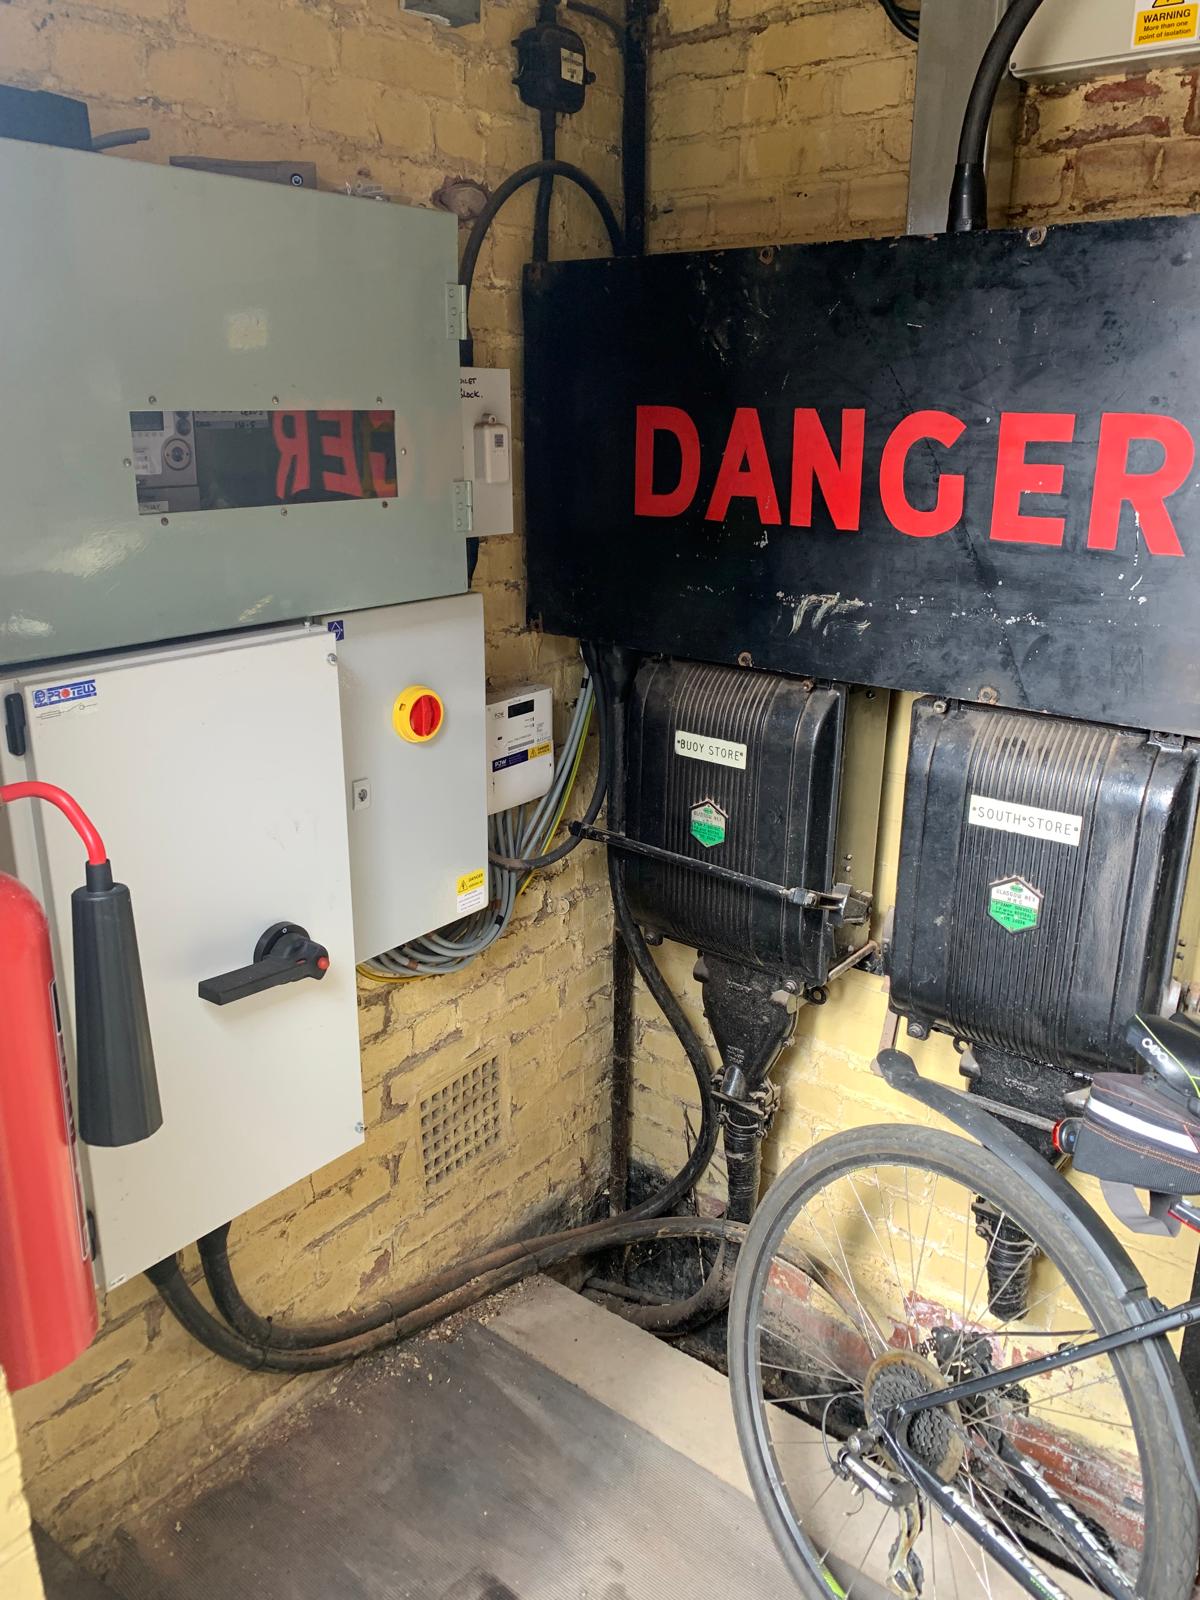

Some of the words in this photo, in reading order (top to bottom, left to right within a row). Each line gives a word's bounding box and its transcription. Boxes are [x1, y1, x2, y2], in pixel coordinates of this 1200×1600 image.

[1143, 8, 1191, 23] WARNING
[1138, 33, 1155, 42] point
[1164, 28, 1192, 37] isolation
[1143, 24, 1160, 32] More
[634, 404, 1195, 557] DANGER
[47, 683, 97, 702] PROTEUS
[680, 738, 706, 754] BUOY
[708, 745, 741, 762] STORE
[977, 806, 1022, 826] SOUTH
[1027, 816, 1072, 836] STORE
